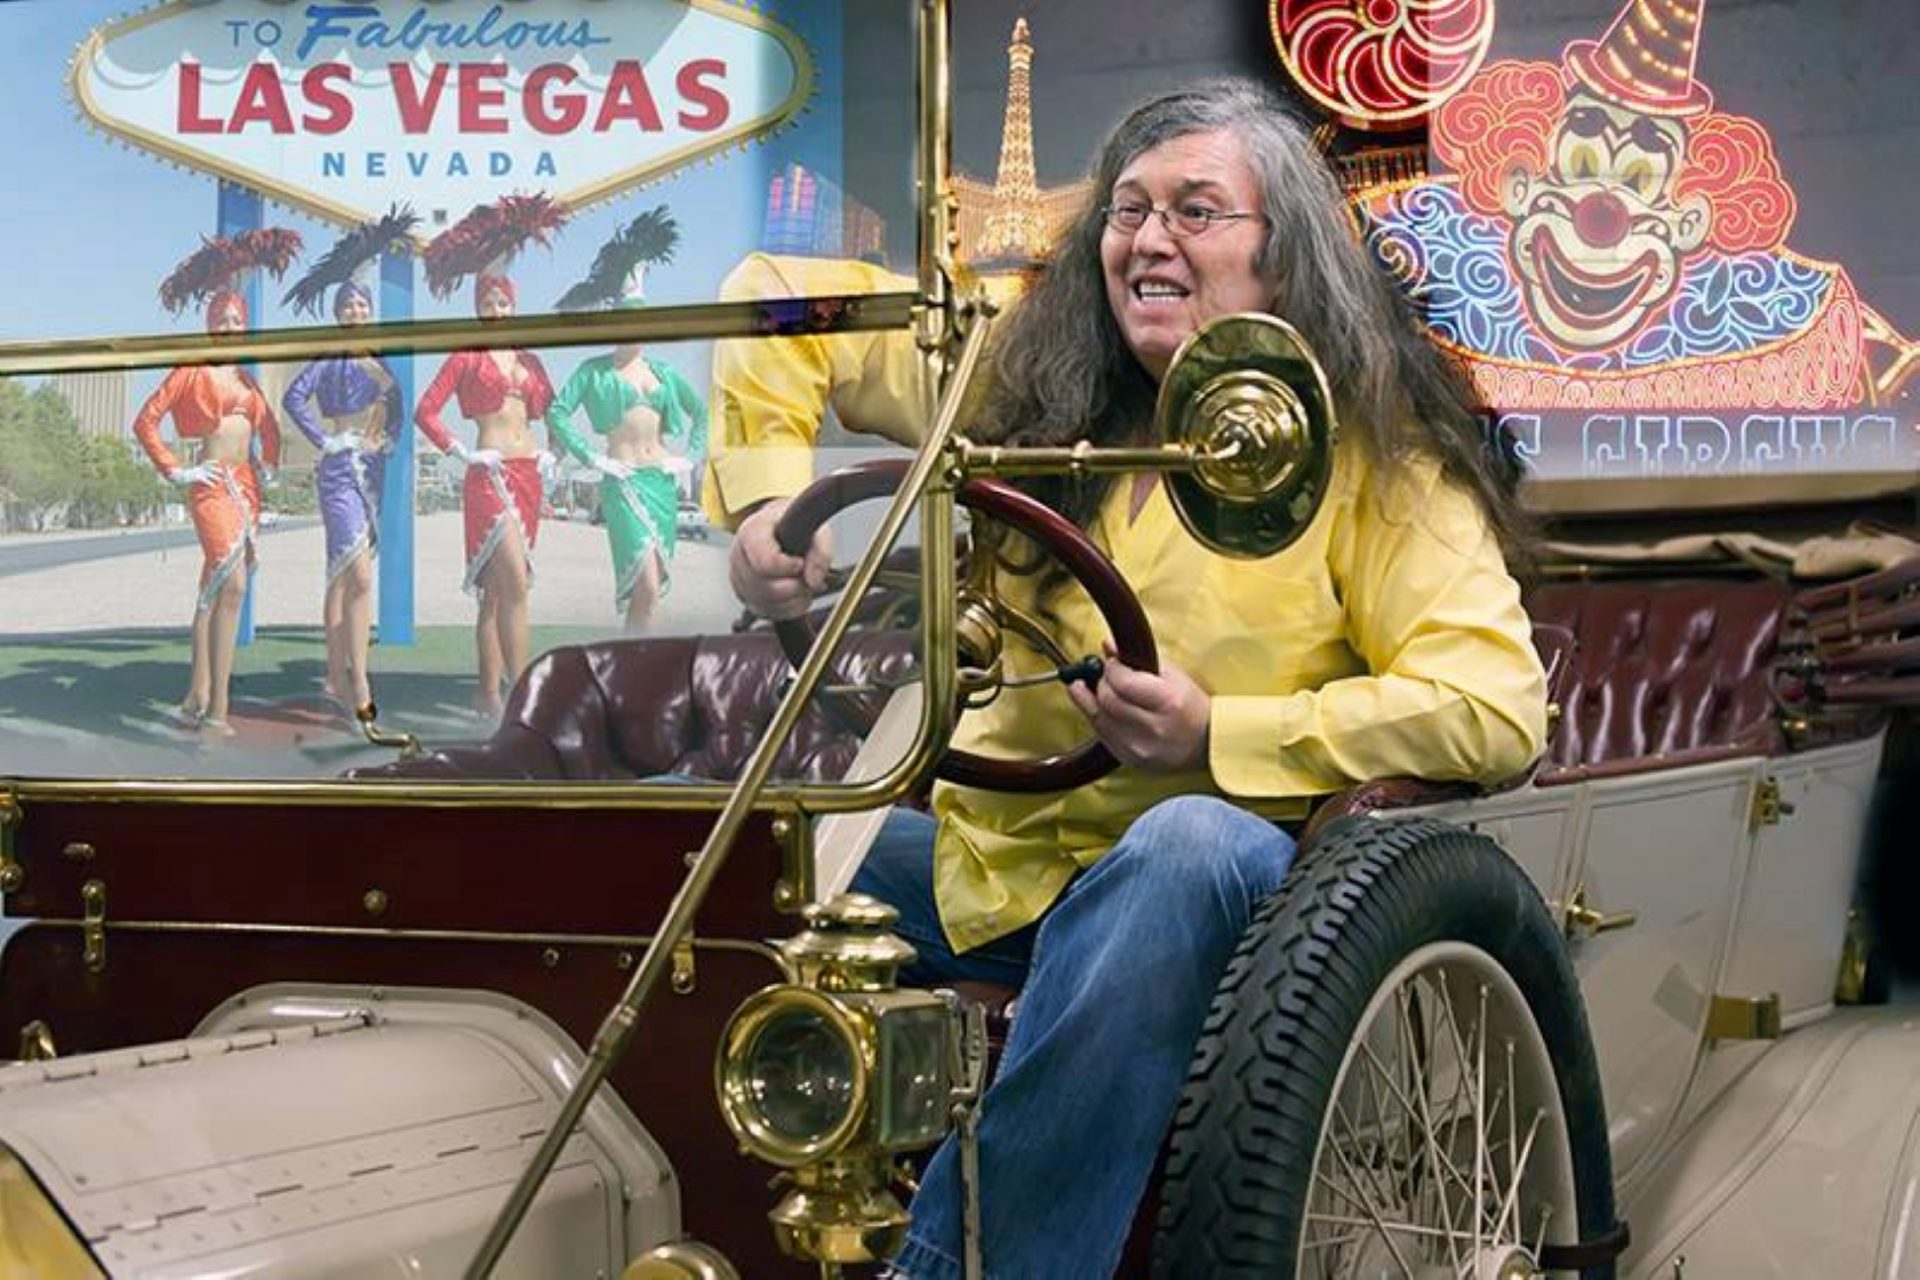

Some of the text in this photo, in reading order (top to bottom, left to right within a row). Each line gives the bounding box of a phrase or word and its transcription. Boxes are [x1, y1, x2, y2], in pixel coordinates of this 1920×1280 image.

[224, 5, 611, 60] TO Fabulous
[177, 59, 731, 136] LAS VEGAS
[322, 151, 557, 177] NEVADA
